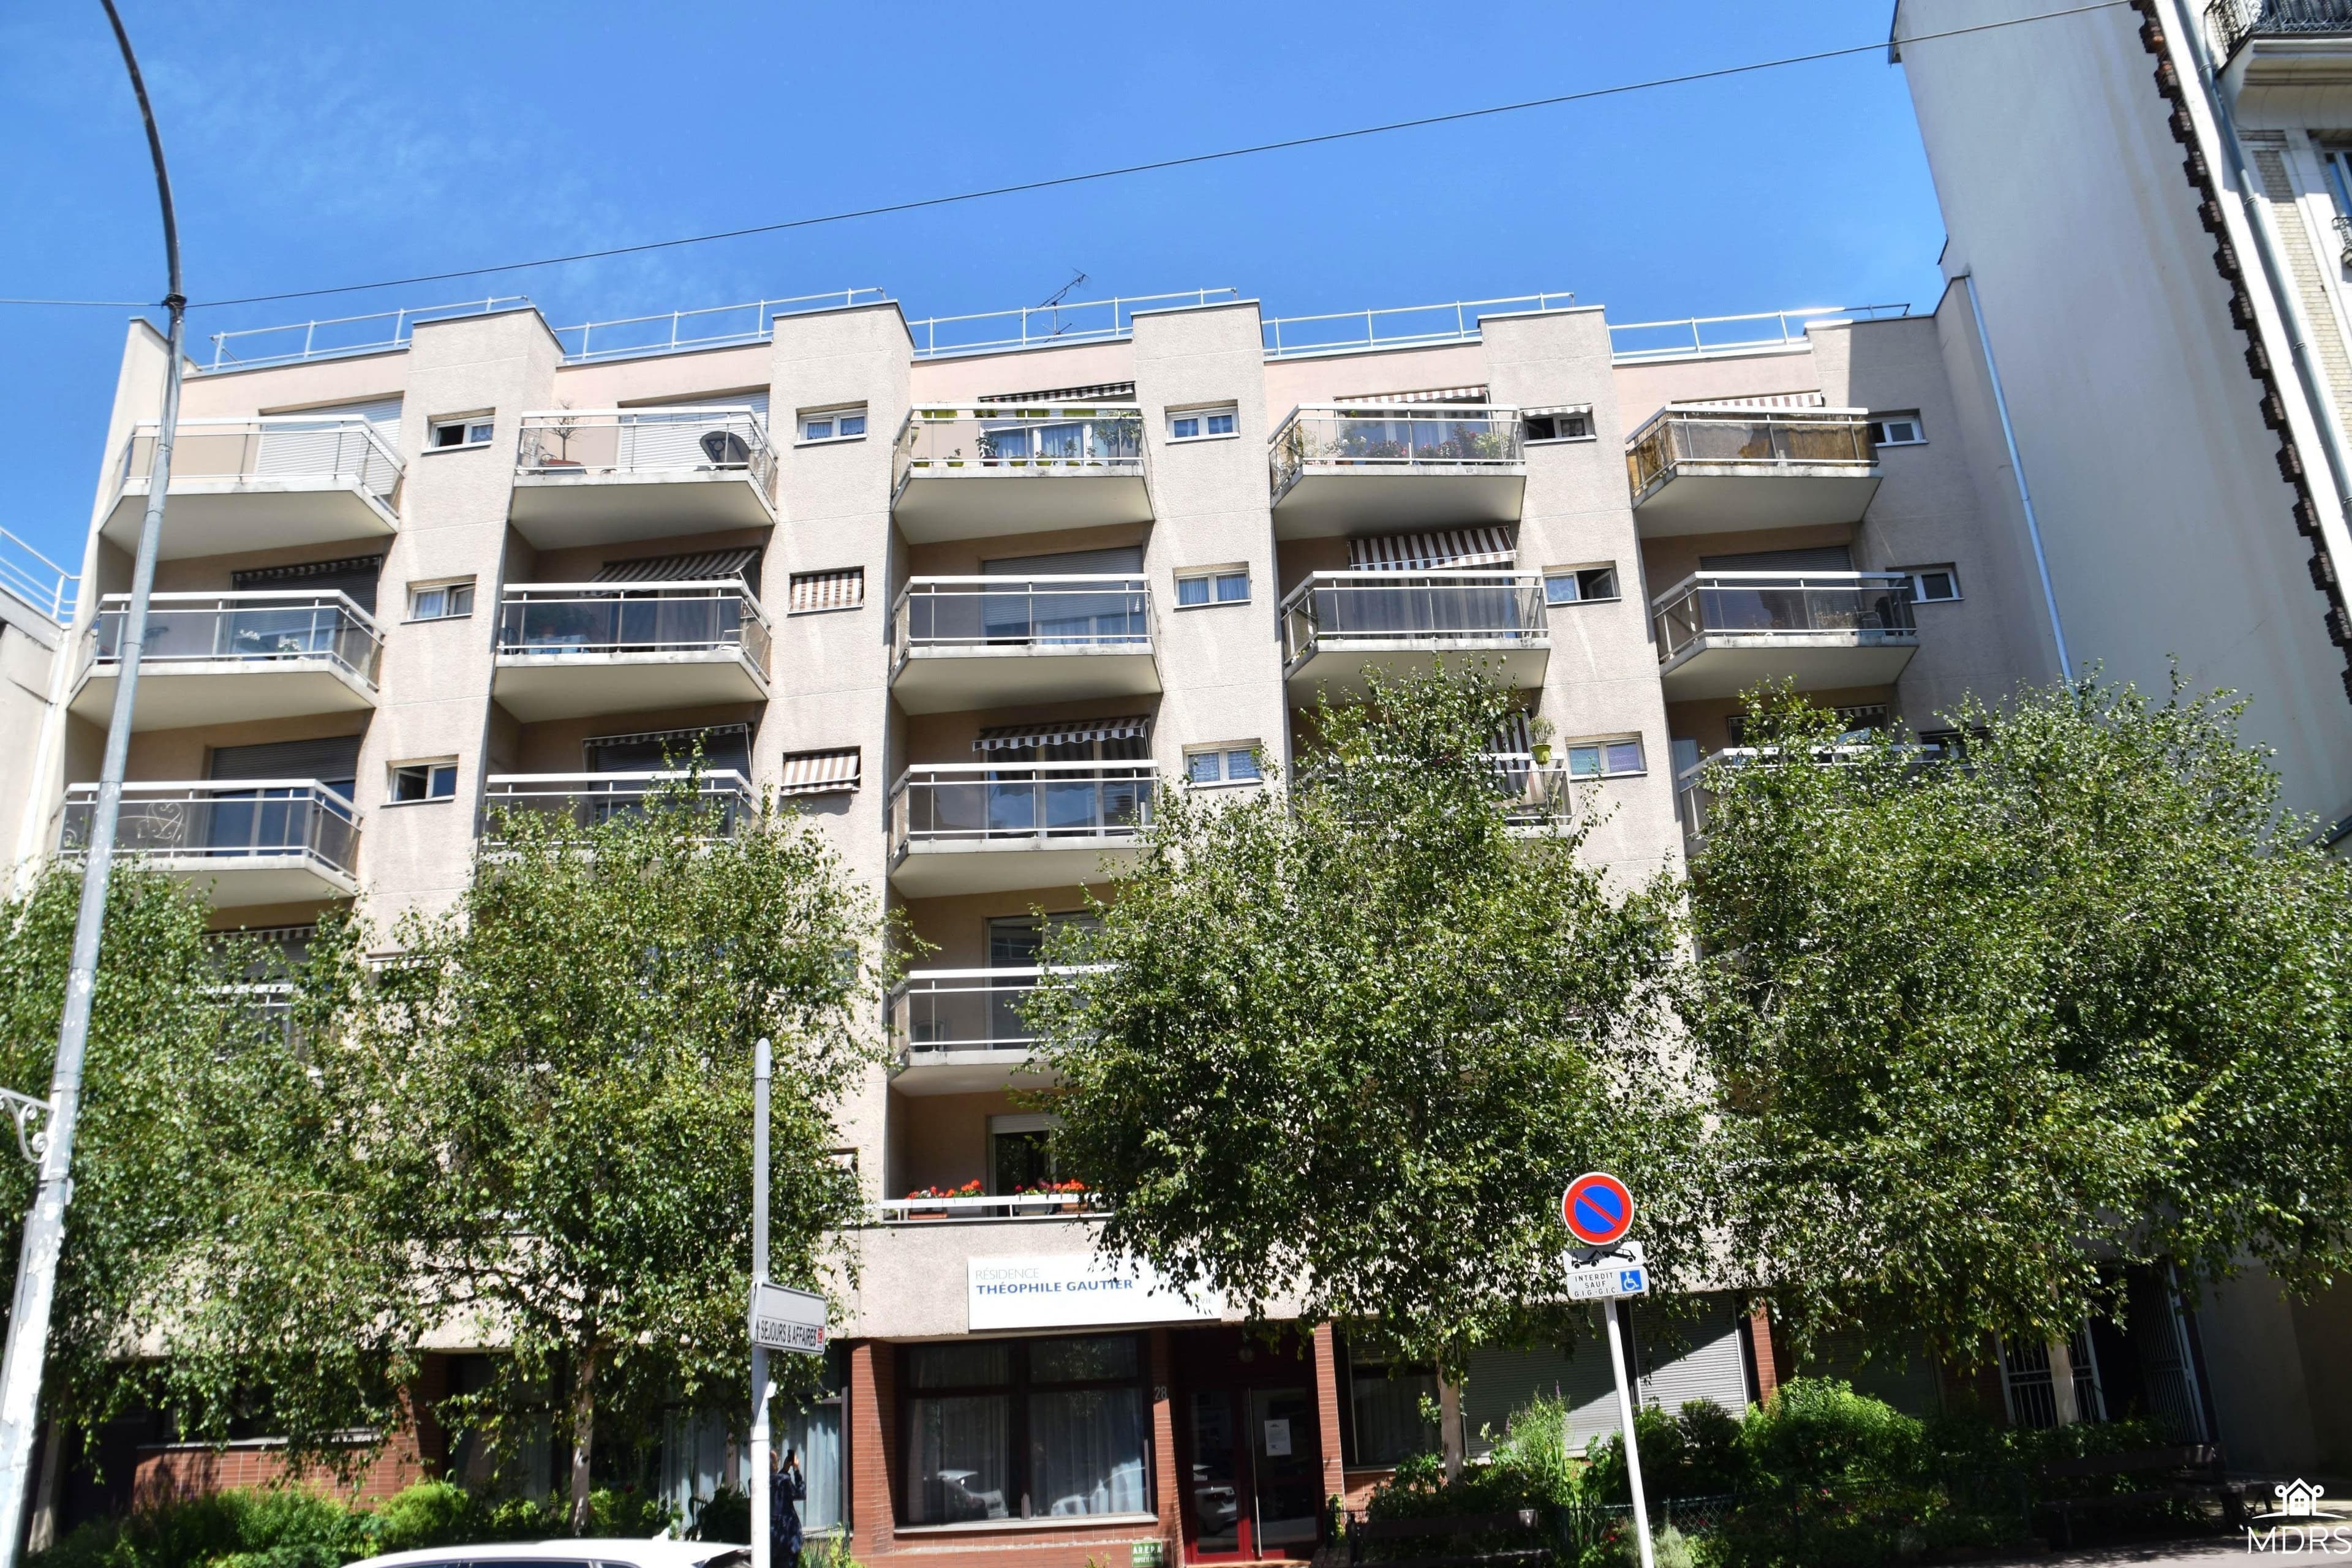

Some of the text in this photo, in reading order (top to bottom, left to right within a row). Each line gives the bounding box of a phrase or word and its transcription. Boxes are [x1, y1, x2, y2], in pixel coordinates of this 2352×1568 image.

[975, 1267, 1039, 1280] RÉSIDENCE
[1575, 1272, 1613, 1282] INTERDIT
[976, 1279, 1133, 1295] THÉOPHILE GAUTIER
[761, 1320, 786, 1343] SEJOURS
[787, 1325, 791, 1343] &
[792, 1326, 816, 1347] AFFAIRES
[1155, 1386, 1167, 1400] 28
